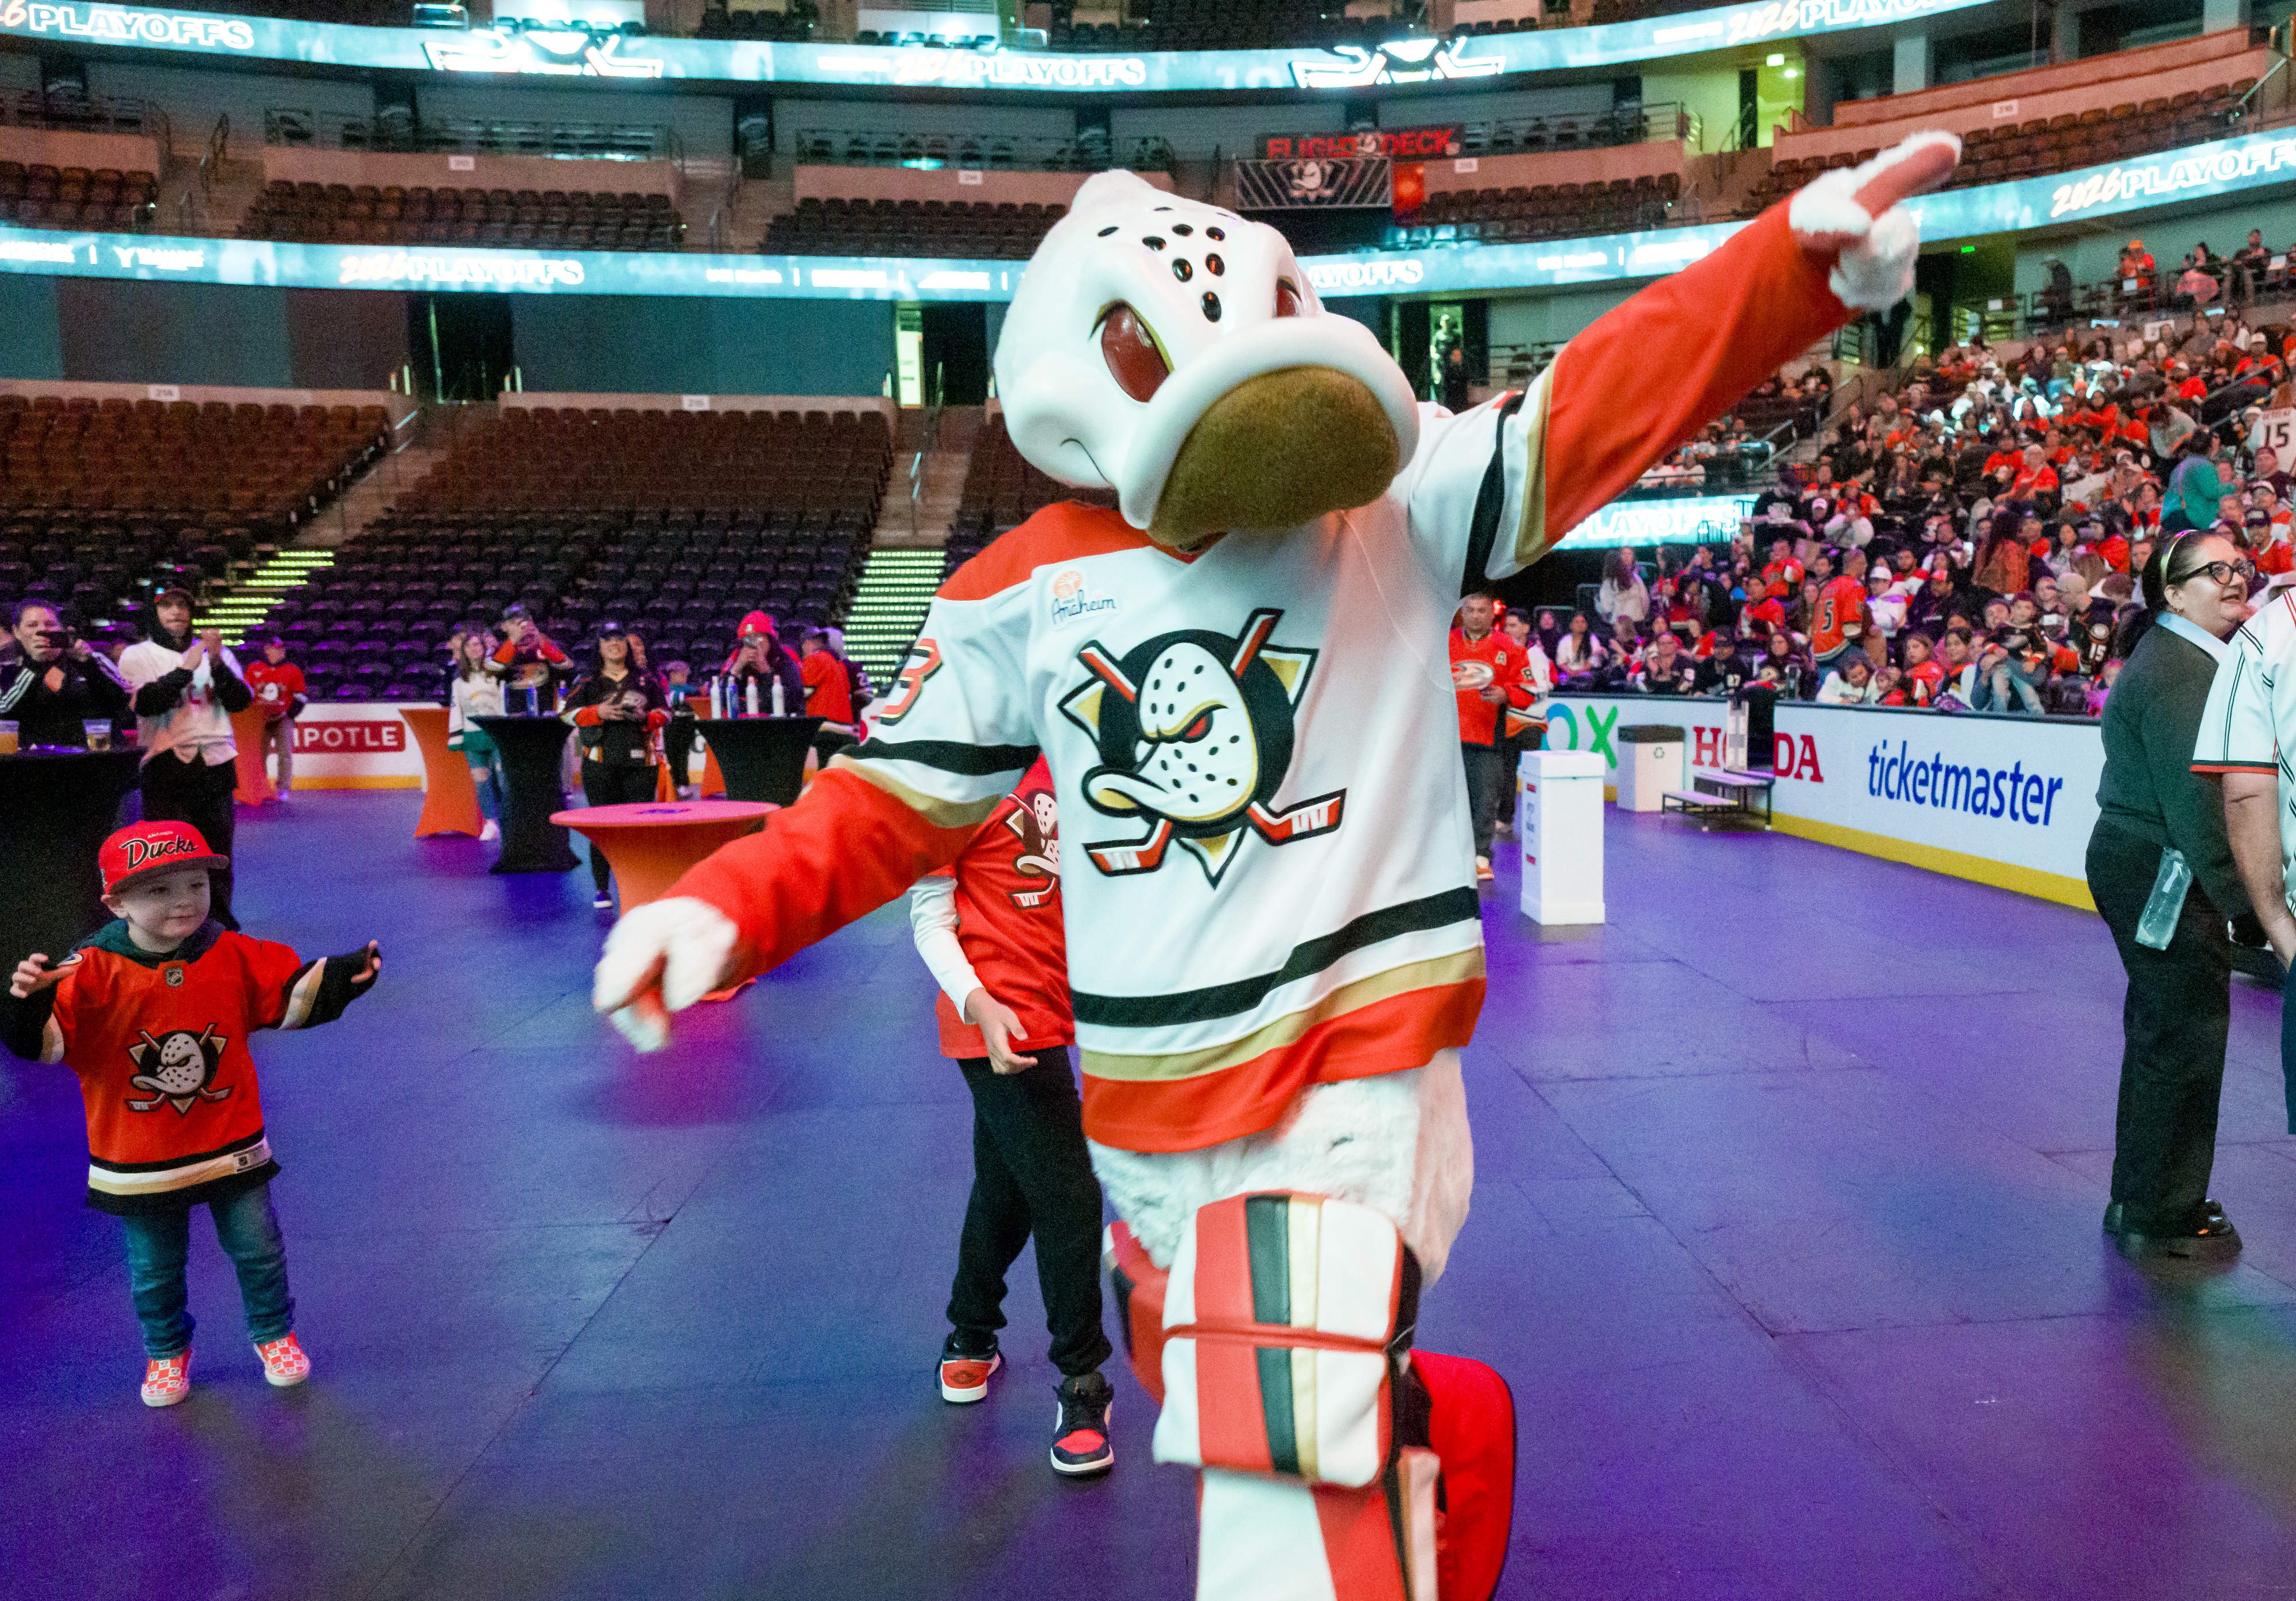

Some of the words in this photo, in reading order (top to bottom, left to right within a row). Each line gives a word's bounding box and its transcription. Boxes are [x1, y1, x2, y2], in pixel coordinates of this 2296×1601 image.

[0, 0, 28, 27] 6
[29, 4, 254, 49] PLAYOFFS
[1725, 0, 1801, 46] 2026
[1799, 0, 1954, 29] PLAY
[965, 56, 1146, 86] PLAYOFFS
[1380, 129, 1453, 155] DECK
[2050, 166, 2122, 219] 2026
[339, 252, 408, 284] 2026
[407, 256, 584, 285] PLAYOFFS
[1307, 259, 1424, 288] AYOFFS
[2263, 422, 2289, 448] 15
[1051, 589, 1116, 625] Anaheim
[1495, 650, 1507, 666] A
[293, 726, 398, 747] IPOTLE
[1539, 702, 1619, 770] OX
[1692, 726, 1824, 783] HDA
[1869, 739, 2064, 826] ticketmaster
[119, 835, 199, 871] Ducks
